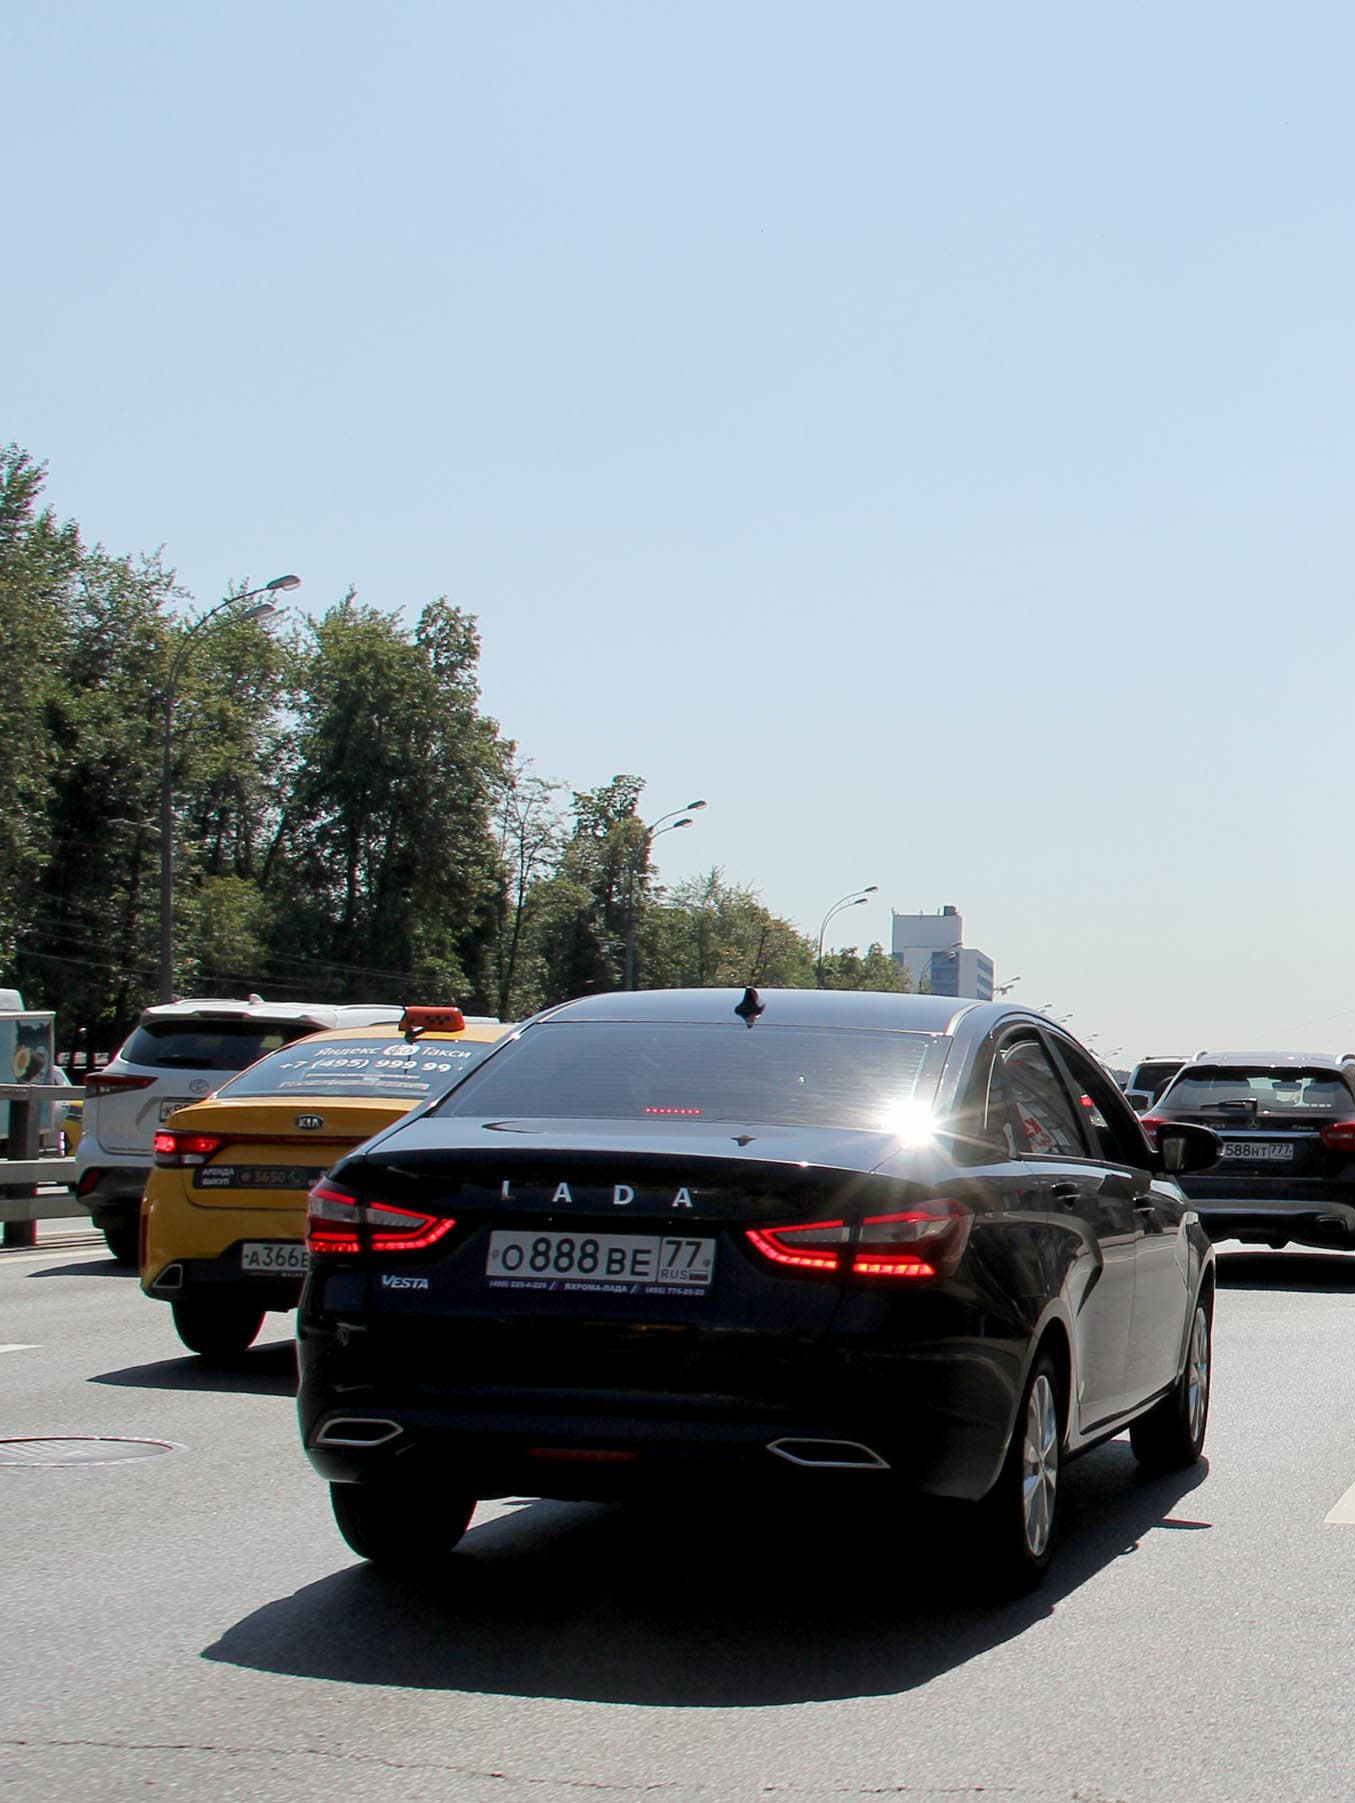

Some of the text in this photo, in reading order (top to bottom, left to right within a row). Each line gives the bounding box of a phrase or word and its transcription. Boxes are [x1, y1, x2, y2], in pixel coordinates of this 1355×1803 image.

[314, 1047, 383, 1058] Яндекс
[421, 1045, 472, 1059] Такси
[309, 1058, 370, 1071] (495)
[374, 1058, 418, 1071] 999
[297, 1117, 321, 1129] KIA
[501, 1180, 694, 1209] LADA
[665, 1239, 703, 1268] 77
[382, 1274, 429, 1289] VESTA
[660, 1269, 688, 1280] RUS
